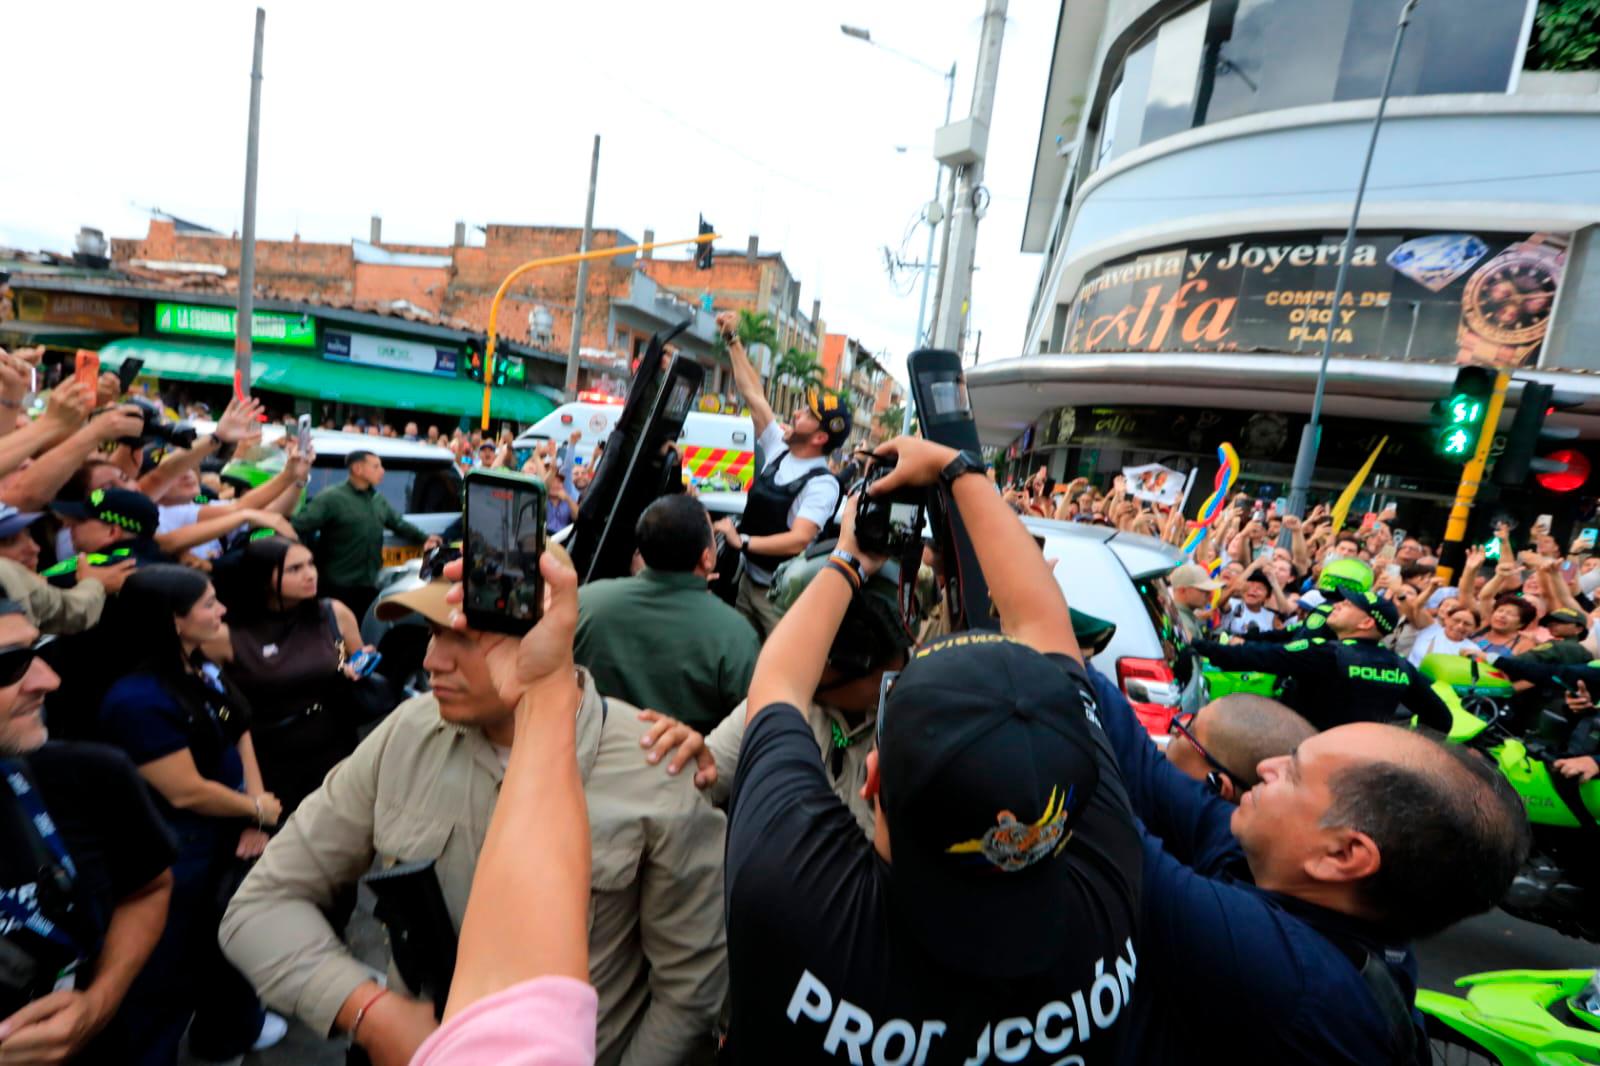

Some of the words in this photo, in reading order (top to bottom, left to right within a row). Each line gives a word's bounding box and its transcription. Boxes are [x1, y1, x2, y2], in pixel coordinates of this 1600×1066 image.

[1187, 251, 1213, 279] y
[1359, 291, 1392, 307] DE
[1085, 279, 1239, 350] Alfa
[1288, 307, 1332, 325] ORO
[1340, 309, 1357, 325] Y
[1348, 665, 1410, 686] POLICÍA
